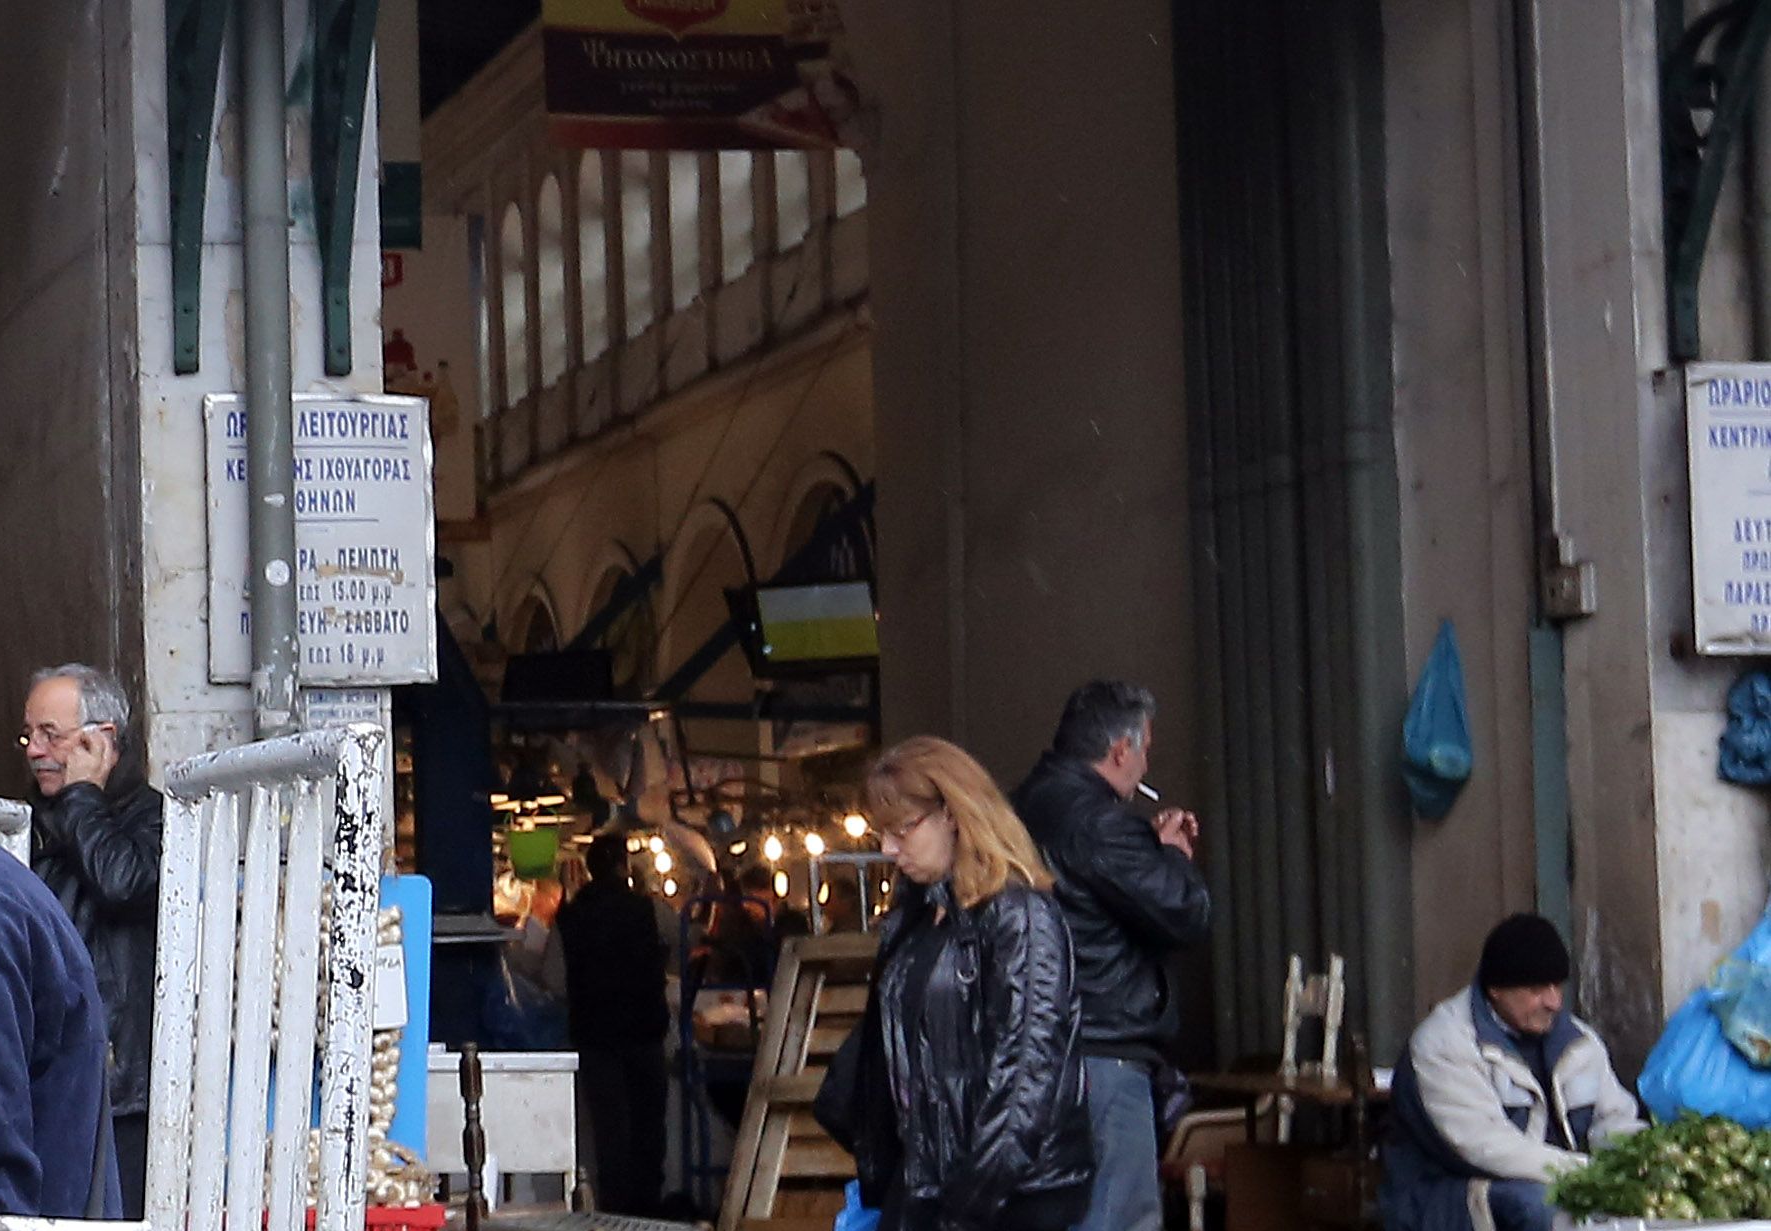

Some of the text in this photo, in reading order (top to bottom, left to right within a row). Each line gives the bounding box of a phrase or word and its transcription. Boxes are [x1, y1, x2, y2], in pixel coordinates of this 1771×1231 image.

[298, 411, 409, 439] ΛΕΙΤΟΥΡΓΙΑΣ
[320, 458, 411, 481] ΙΧΘΥΑΓΟΡΑΣ
[295, 489, 356, 513] ΘΗΝΩΝ
[338, 548, 399, 572] ΠΕΜΠΤΗ
[332, 581, 366, 601] 15.00
[345, 611, 409, 634] ΣΑΒΒΑΤΟ
[340, 643, 354, 664] 18
